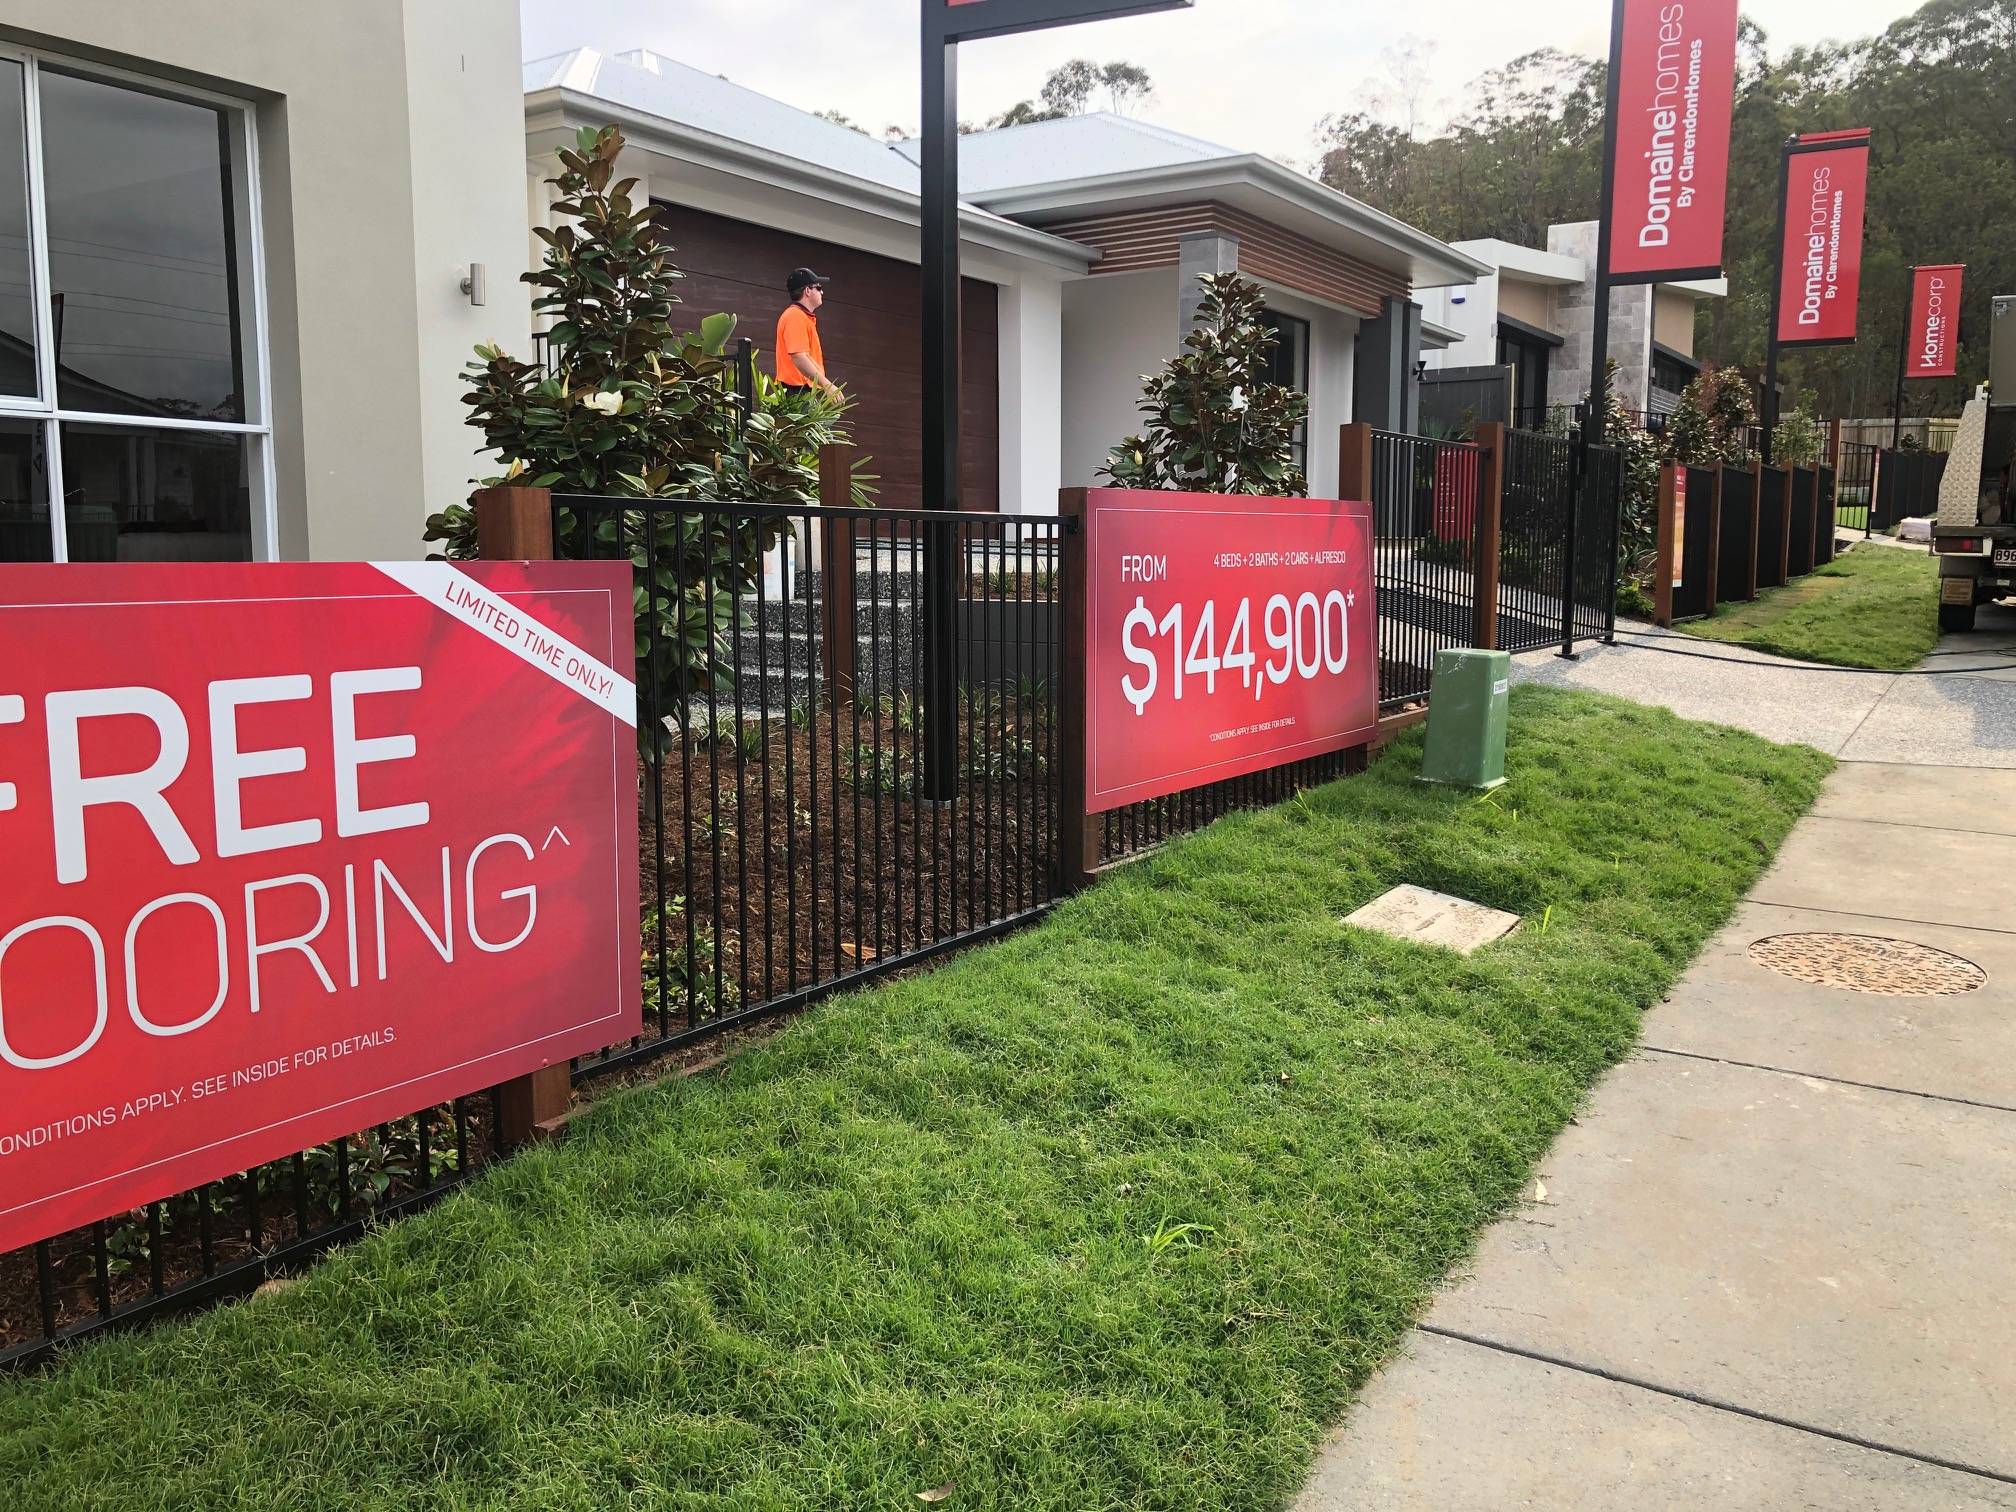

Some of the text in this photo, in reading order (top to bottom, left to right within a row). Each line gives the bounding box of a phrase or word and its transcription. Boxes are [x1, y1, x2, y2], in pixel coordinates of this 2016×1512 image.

[1638, 3, 1684, 248] Domainehomes
[1677, 39, 1703, 208] By ClarendonHomes
[1799, 167, 1831, 324] Domainehomes
[1825, 190, 1843, 299] By ClarendonHomes
[1120, 555, 1167, 582] FROM
[1213, 553, 1220, 567] 4
[1221, 553, 1242, 568] BEDS
[1249, 553, 1255, 567] 2
[1255, 552, 1279, 566] BATHS
[1285, 552, 1290, 565] 2
[1291, 551, 1309, 565] CARS
[1314, 550, 1346, 564] ALFRESCO
[445, 581, 614, 699] LIMITED TIME ONLY!
[0, 665, 430, 885] REE
[121, 1086, 187, 1121] APPLY.
[191, 1074, 228, 1100] SEE
[232, 1060, 290, 1088] INSIDE
[293, 1045, 329, 1070] FOR
[331, 1026, 398, 1059] DETAILS.
